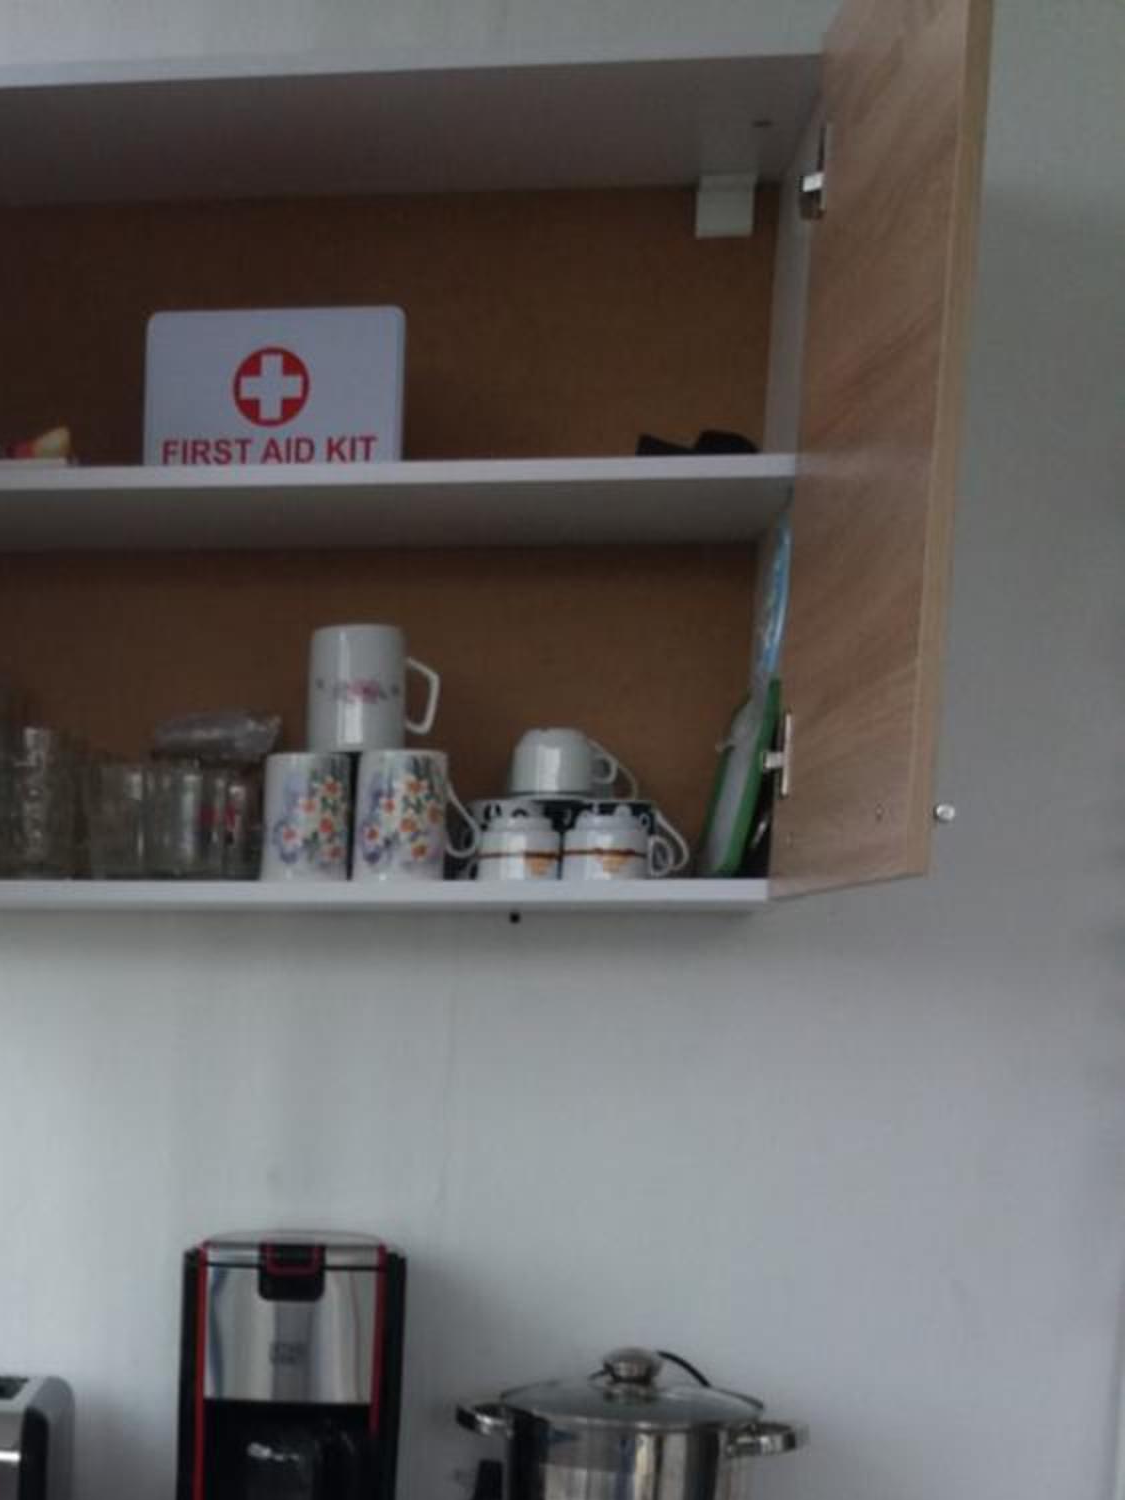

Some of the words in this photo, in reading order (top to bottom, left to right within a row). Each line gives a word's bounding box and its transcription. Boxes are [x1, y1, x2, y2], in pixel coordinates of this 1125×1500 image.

[161, 438, 252, 465] FIRST
[261, 437, 316, 464] AID
[326, 435, 377, 463] KIT
